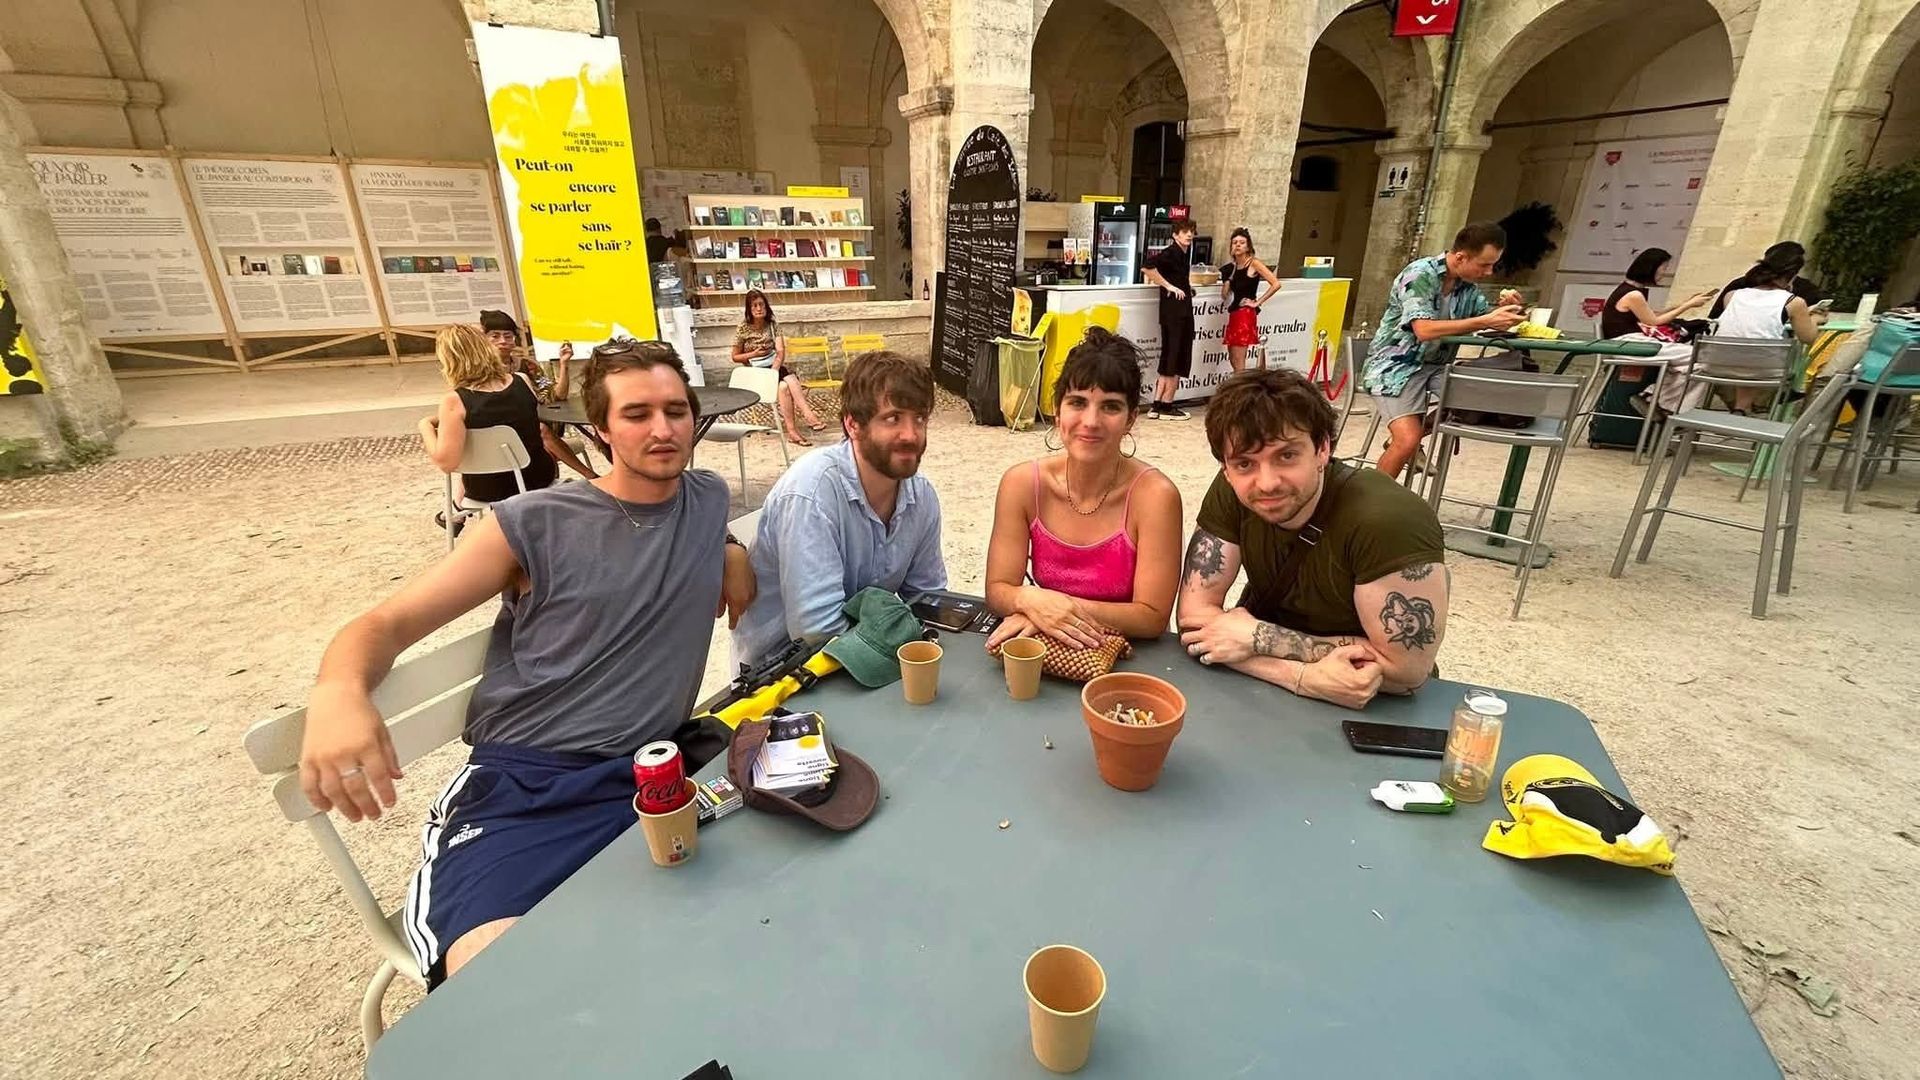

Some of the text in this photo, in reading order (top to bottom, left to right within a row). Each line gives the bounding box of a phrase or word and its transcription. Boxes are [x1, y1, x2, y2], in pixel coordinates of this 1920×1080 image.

[515, 158, 574, 173] Peut-on
[55, 173, 107, 186] PARLER
[569, 181, 617, 194] encore
[530, 198, 592, 215] se parler
[582, 222, 612, 233] sans
[578, 238, 632, 252] se haïr ?
[1192, 301, 1207, 316] nd
[1193, 327, 1213, 341] rise
[1273, 319, 1307, 334] rendra
[1179, 374, 1200, 390] vals
